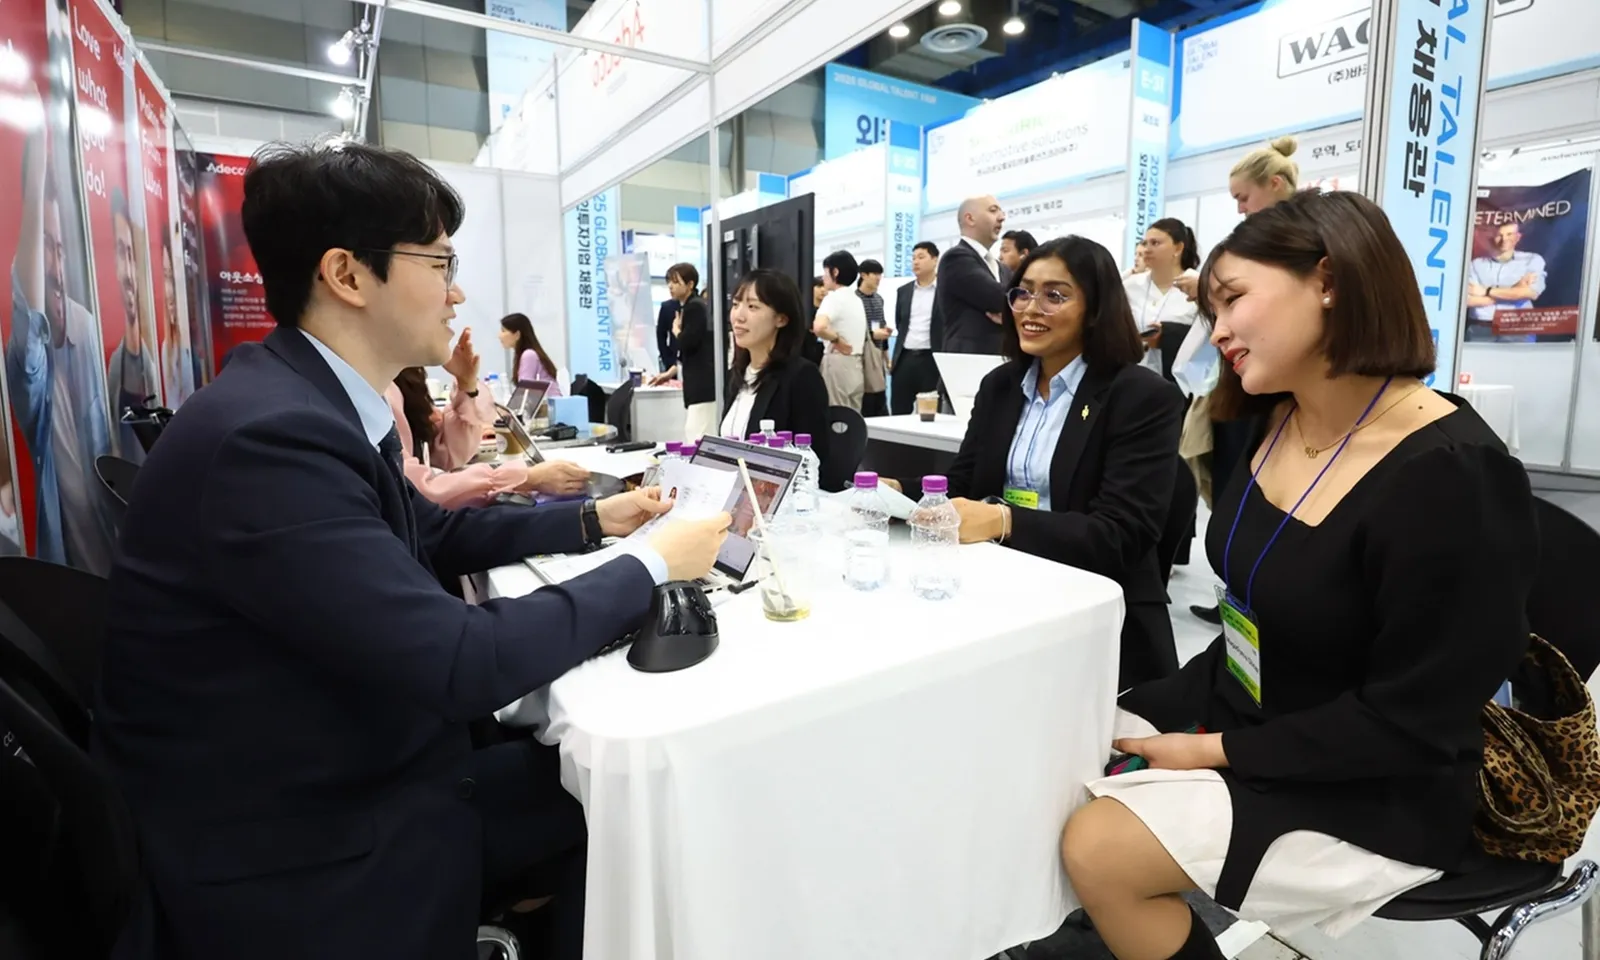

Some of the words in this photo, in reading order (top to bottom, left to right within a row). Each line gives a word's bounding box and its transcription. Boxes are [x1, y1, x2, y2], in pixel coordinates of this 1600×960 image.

[73, 5, 101, 61] Love
[78, 67, 109, 112] what
[1403, 18, 1438, 198] 채용관
[1031, 121, 1089, 150] solutions
[1312, 144, 1340, 160] 무역,
[86, 162, 107, 199] do!
[1148, 155, 1160, 198] 2025
[1423, 74, 1462, 312] TALENT
[593, 215, 608, 276] GLOBAL
[579, 270, 593, 309] 채용관
[596, 280, 611, 336] TALENT
[599, 339, 612, 372] FAIR
